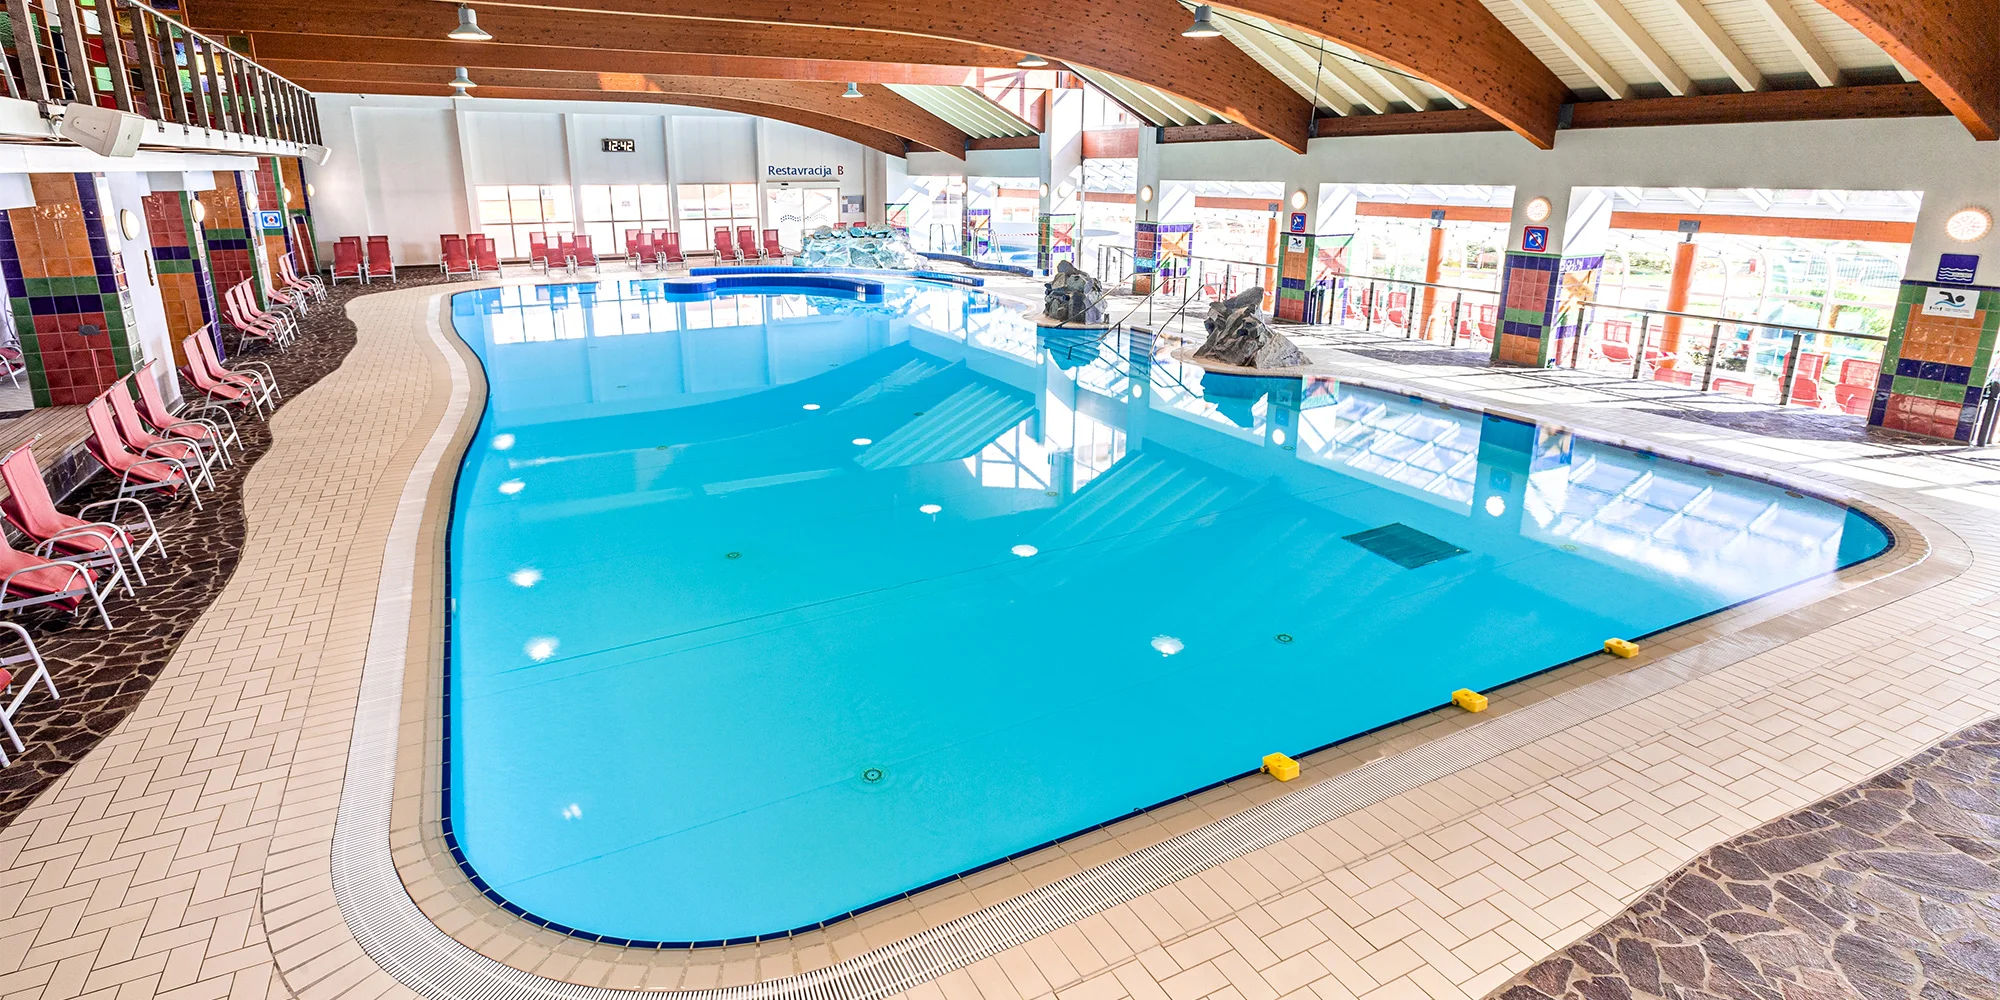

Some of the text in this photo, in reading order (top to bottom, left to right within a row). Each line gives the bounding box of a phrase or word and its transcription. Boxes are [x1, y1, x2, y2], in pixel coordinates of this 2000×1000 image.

[608, 140, 634, 152] 12:42
[768, 165, 845, 178] Restavracija B
